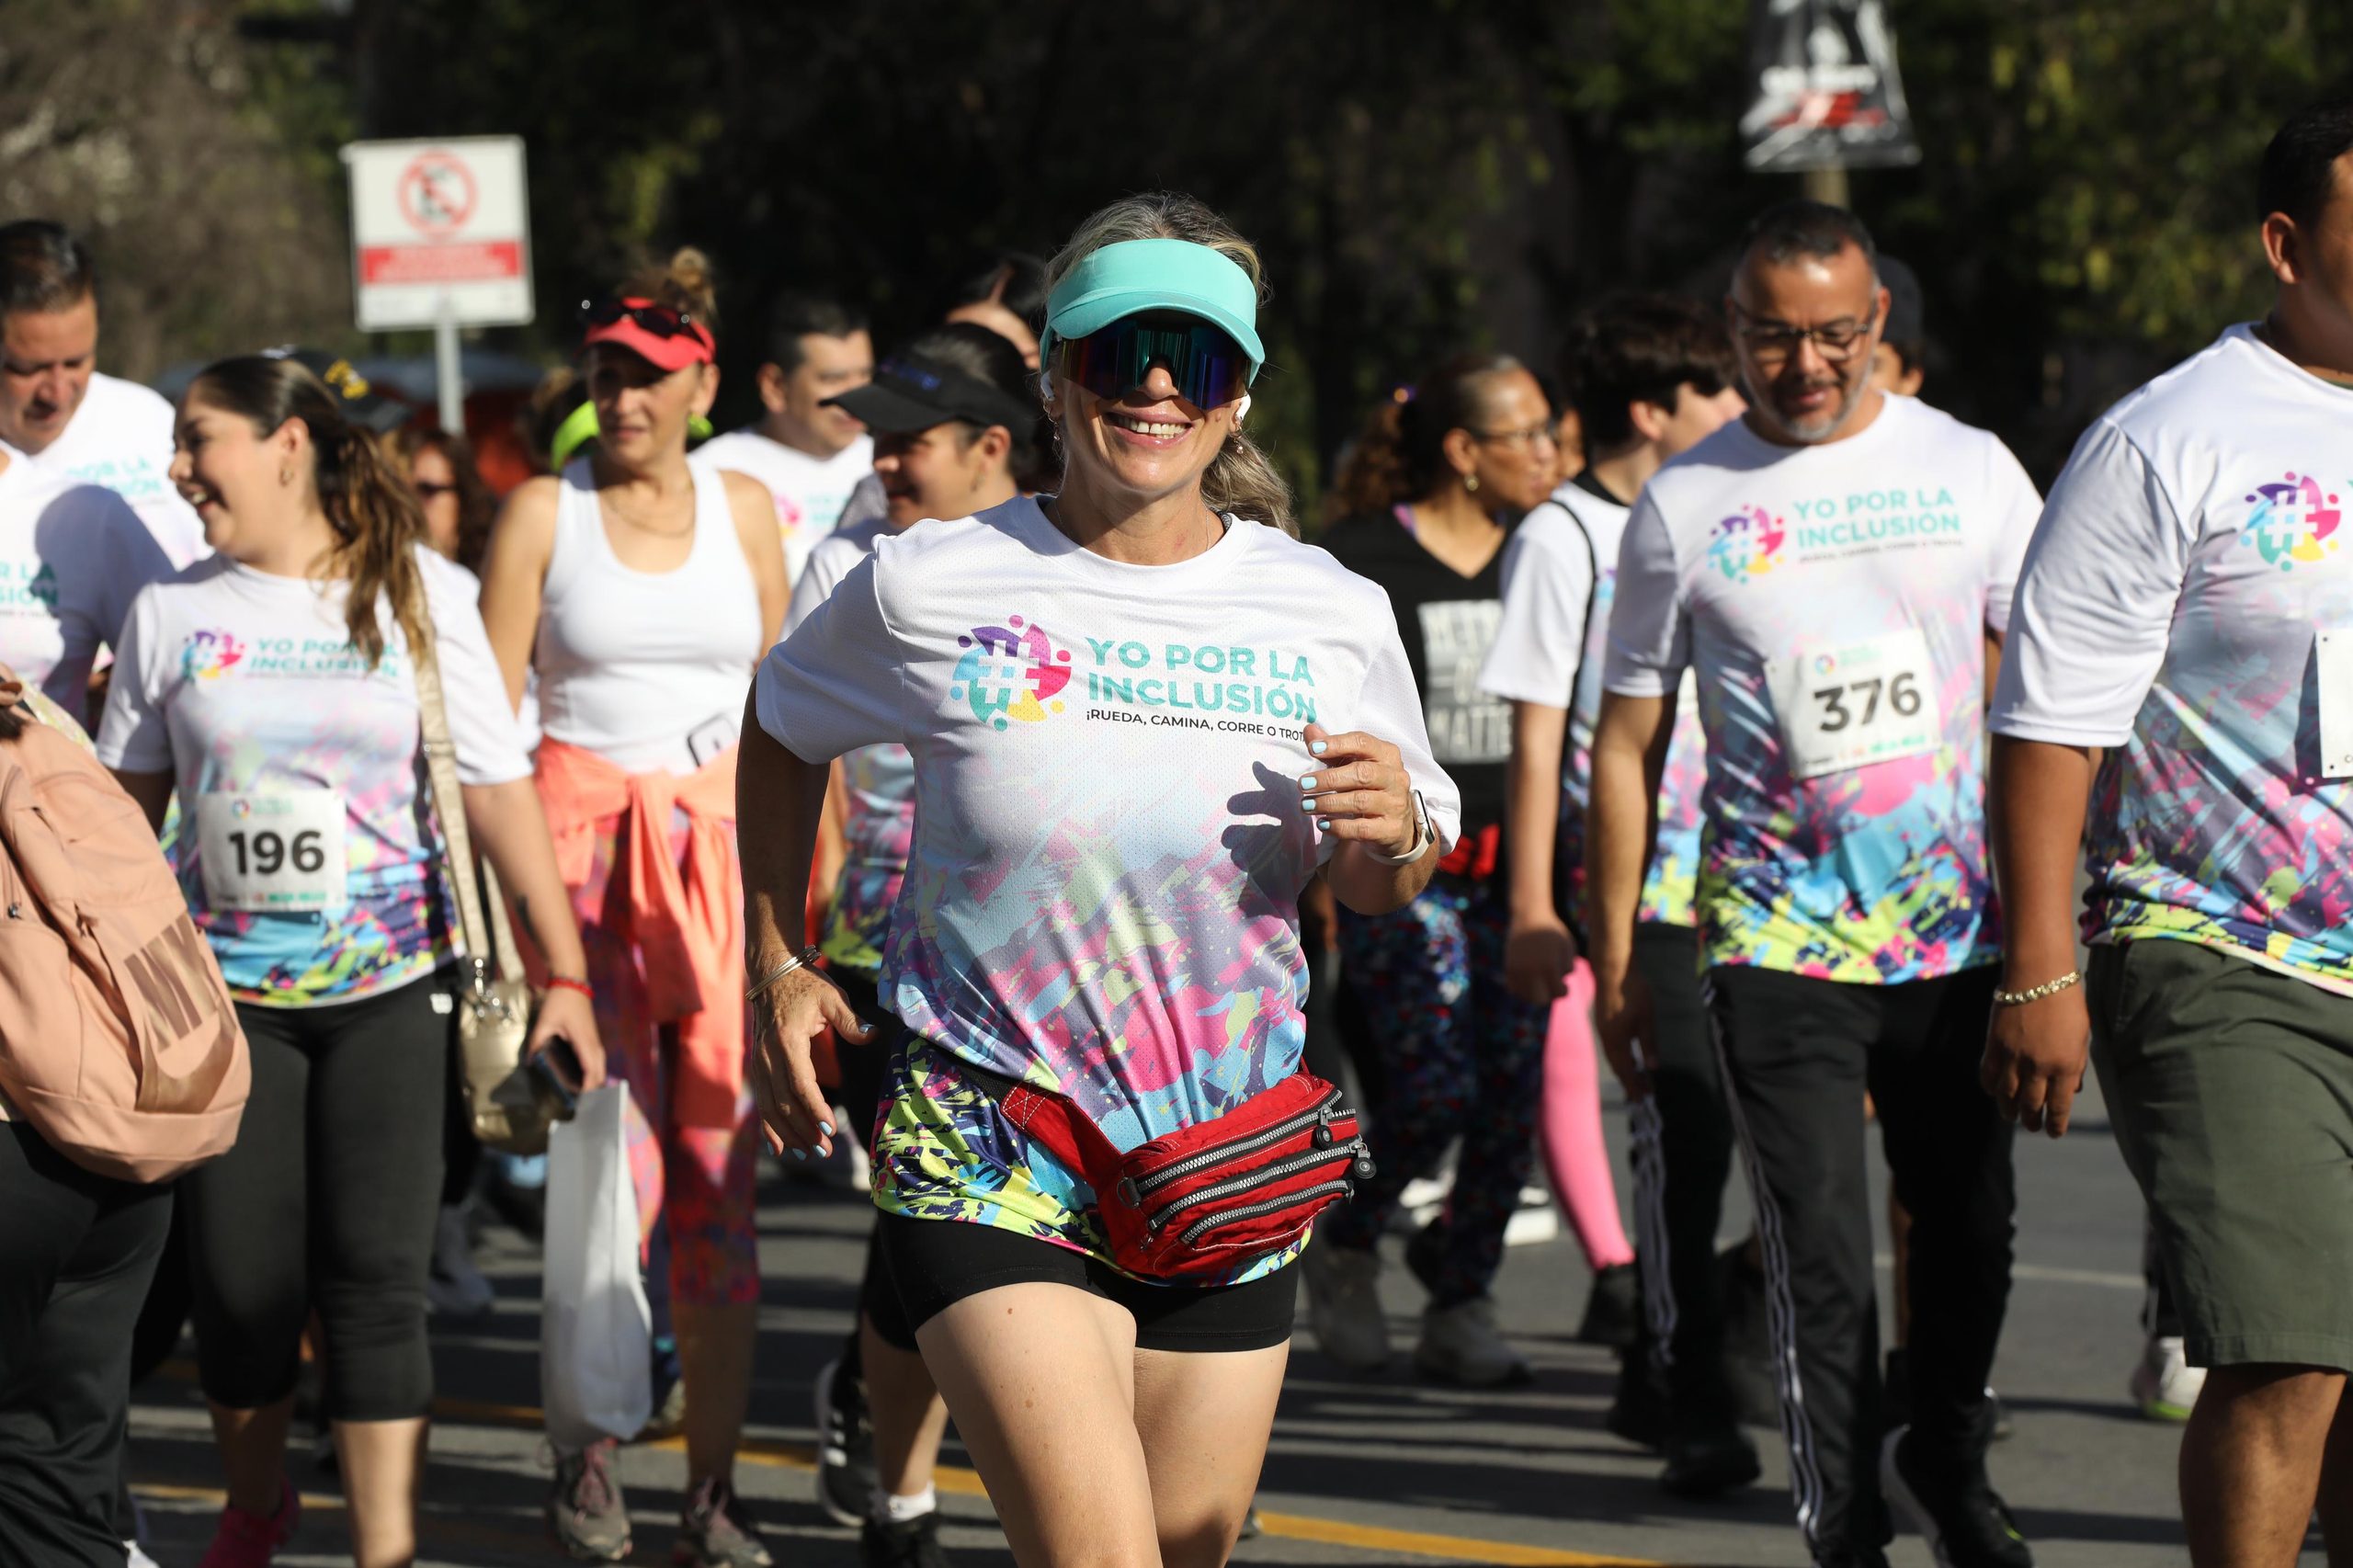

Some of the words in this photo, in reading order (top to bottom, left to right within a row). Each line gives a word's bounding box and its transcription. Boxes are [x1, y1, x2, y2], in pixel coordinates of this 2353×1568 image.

[1793, 498, 1837, 519] YO
[1847, 489, 1907, 516] POR
[1916, 486, 1955, 507] LA
[258, 638, 294, 654] YO
[1085, 636, 1151, 669] YO
[1165, 643, 1256, 676] POR
[1269, 650, 1315, 687] LA
[1088, 672, 1317, 723] INCLUSIÓN
[1813, 672, 1921, 732] 376
[1086, 709, 1147, 726] ¡RUEDA,
[1151, 715, 1214, 732] CAMINA,
[1217, 720, 1265, 735] CORRE
[1267, 725, 1277, 736] O
[1279, 727, 1306, 743] TROT
[228, 829, 324, 875] 196
